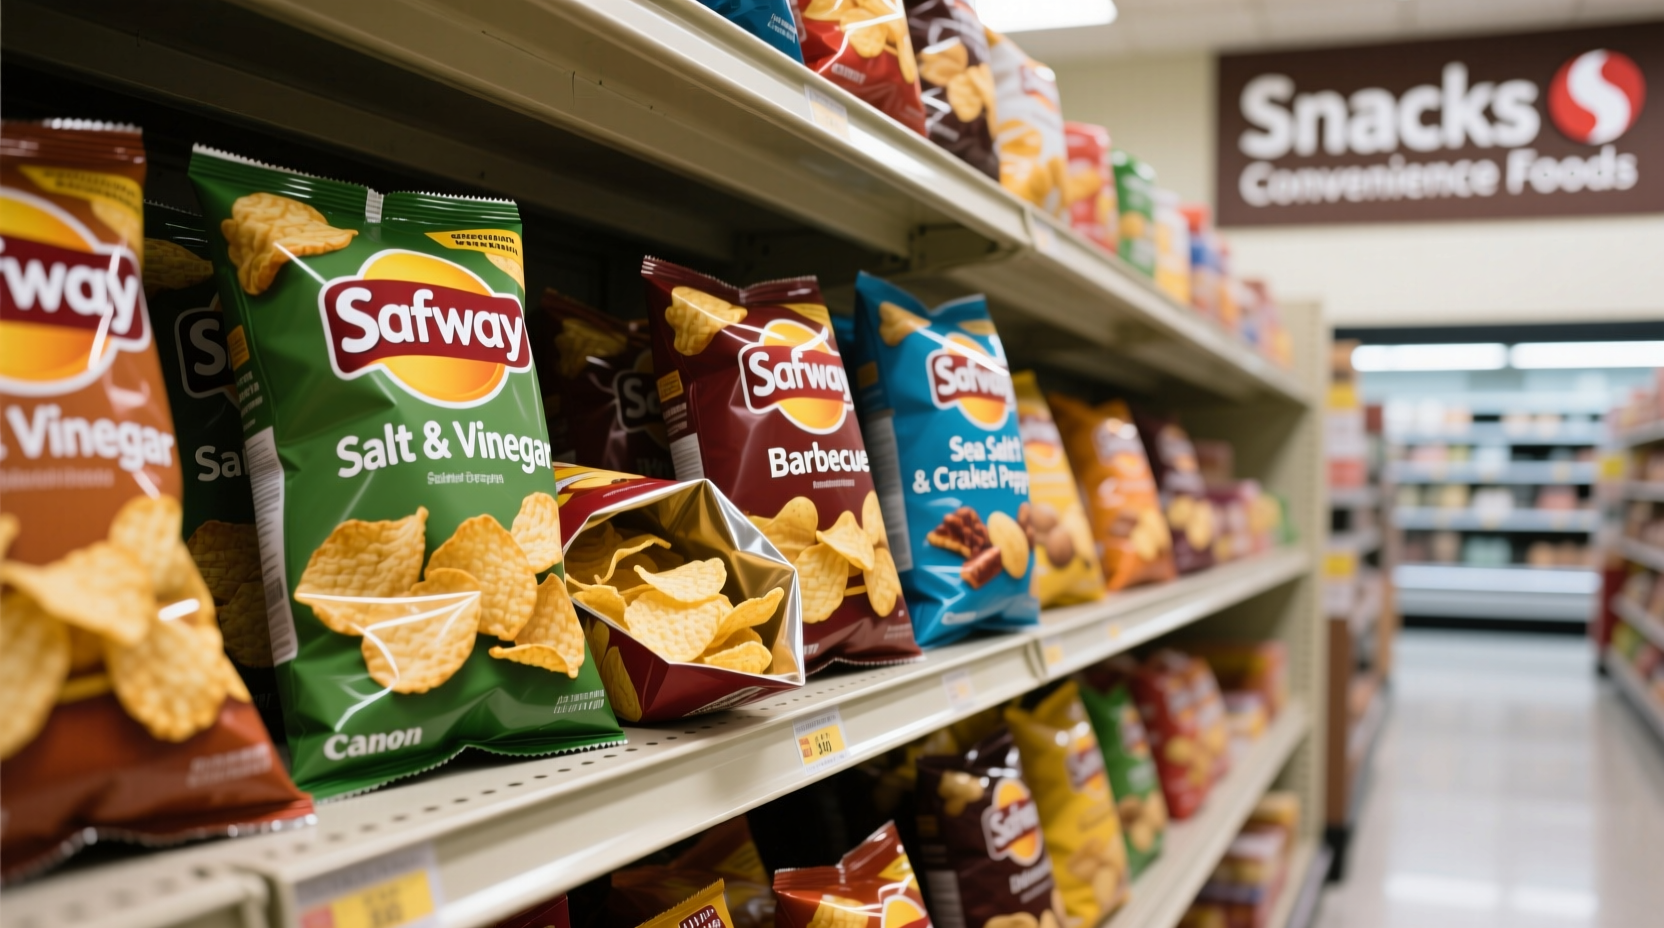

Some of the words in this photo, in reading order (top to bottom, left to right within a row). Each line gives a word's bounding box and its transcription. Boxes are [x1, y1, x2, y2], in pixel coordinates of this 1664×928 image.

[1238, 60, 1541, 160] Snacks
[1238, 152, 1501, 207] Convenience
[1506, 144, 1638, 195] Foods
[335, 286, 523, 362] Safway
[748, 351, 851, 403] Safway
[5, 403, 174, 472] Vinegar
[336, 422, 417, 478] Salt
[422, 420, 452, 460] &
[452, 420, 551, 474] Vinegar
[767, 441, 870, 478] Barbecue
[949, 435, 986, 462] Sea
[912, 469, 931, 494] &
[323, 726, 422, 761] Canon
